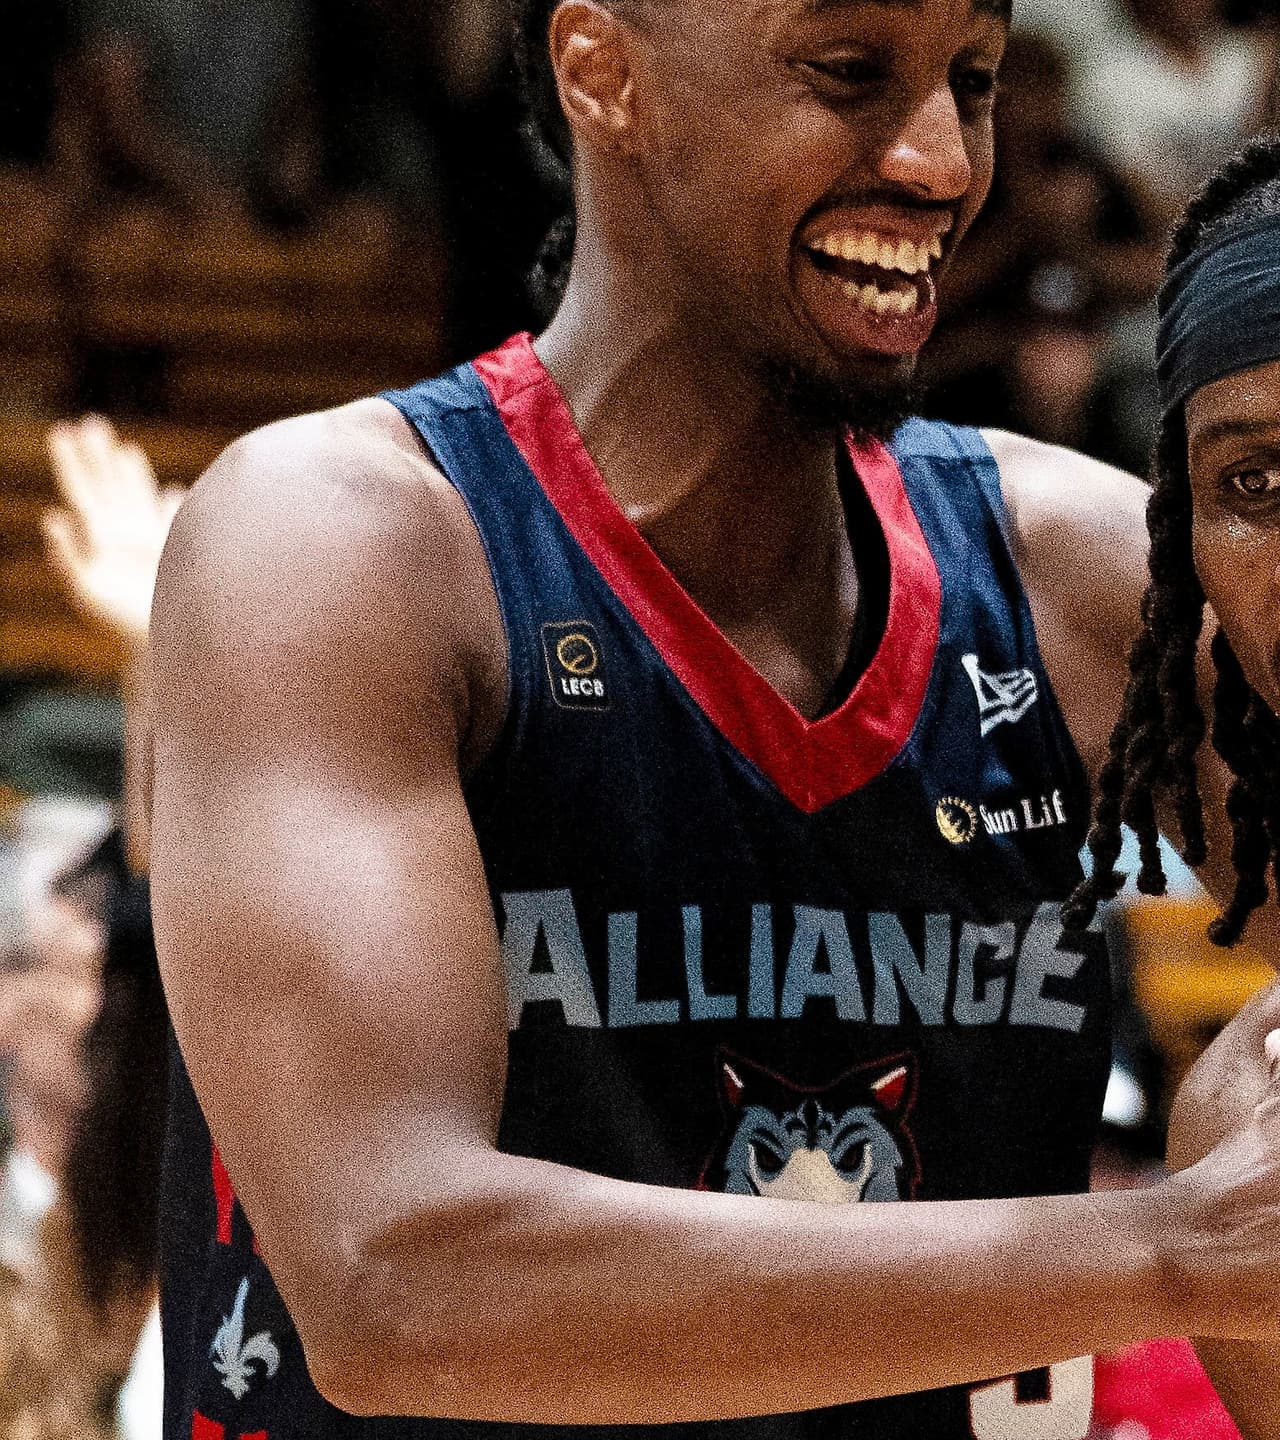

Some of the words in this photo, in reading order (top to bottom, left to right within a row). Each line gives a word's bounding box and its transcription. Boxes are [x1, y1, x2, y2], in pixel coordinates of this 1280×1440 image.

[979, 803, 1019, 835] Sun
[1020, 788, 1067, 829] Lif
[500, 887, 1104, 1033] ALLIANCE
